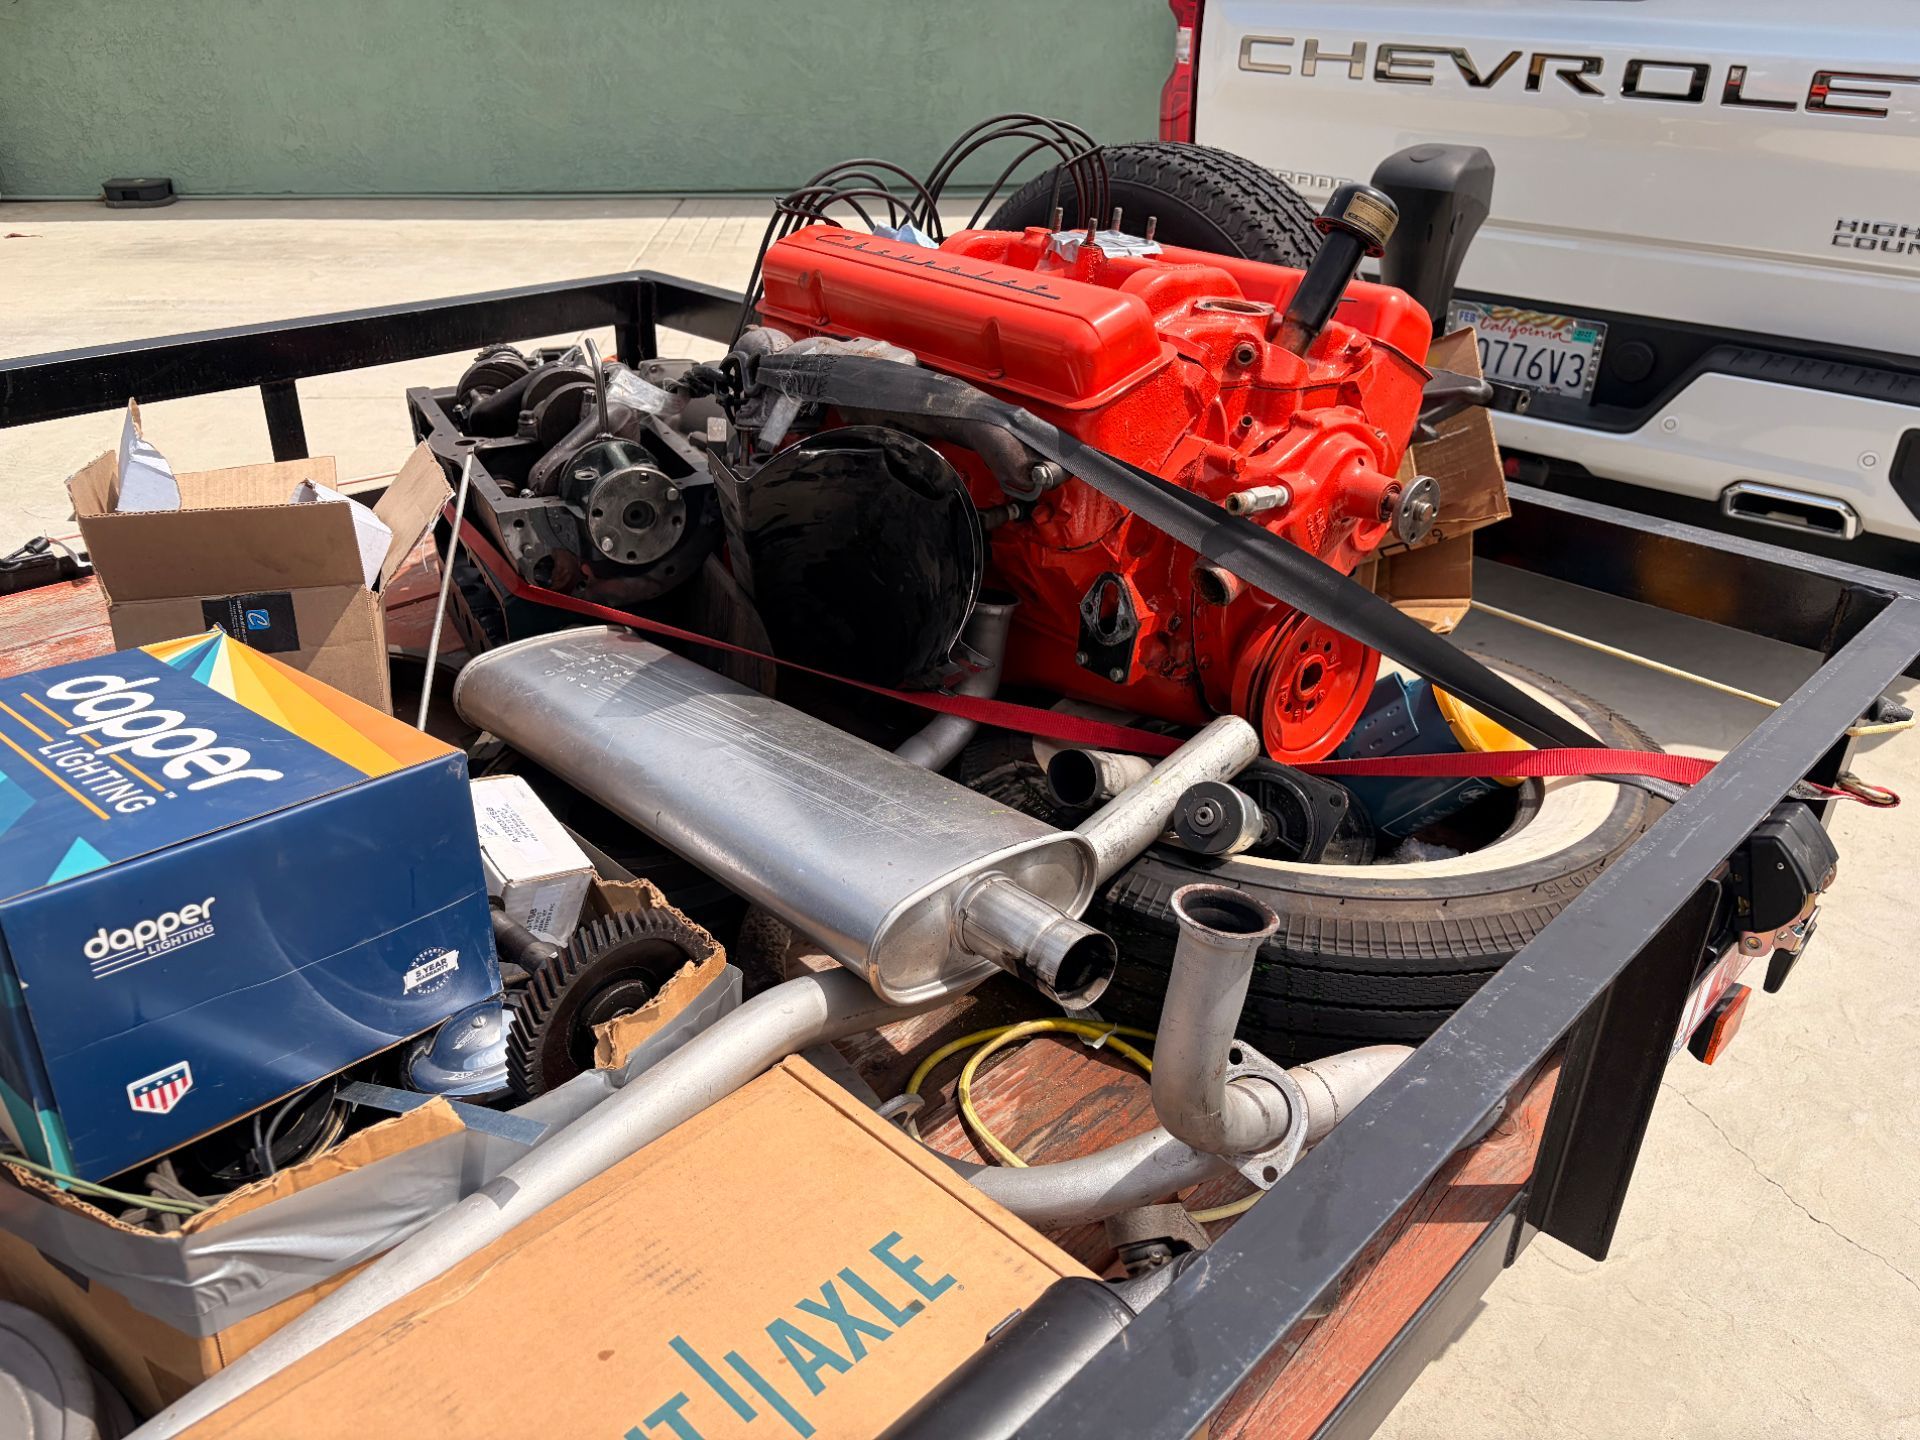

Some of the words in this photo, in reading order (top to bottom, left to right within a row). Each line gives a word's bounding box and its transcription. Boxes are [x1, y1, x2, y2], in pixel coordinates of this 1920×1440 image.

[1238, 35, 1920, 118] CHEVROLE
[1459, 310, 1476, 322] FEB
[1479, 316, 1572, 343] California
[1478, 338, 1585, 388] 0776V3
[46, 675, 284, 790] dapper
[38, 739, 157, 813] LIGHTING
[83, 896, 215, 959] dapper
[147, 924, 215, 955] LIGHTING
[423, 958, 448, 973] YEAR
[765, 1231, 958, 1397] AXLE
